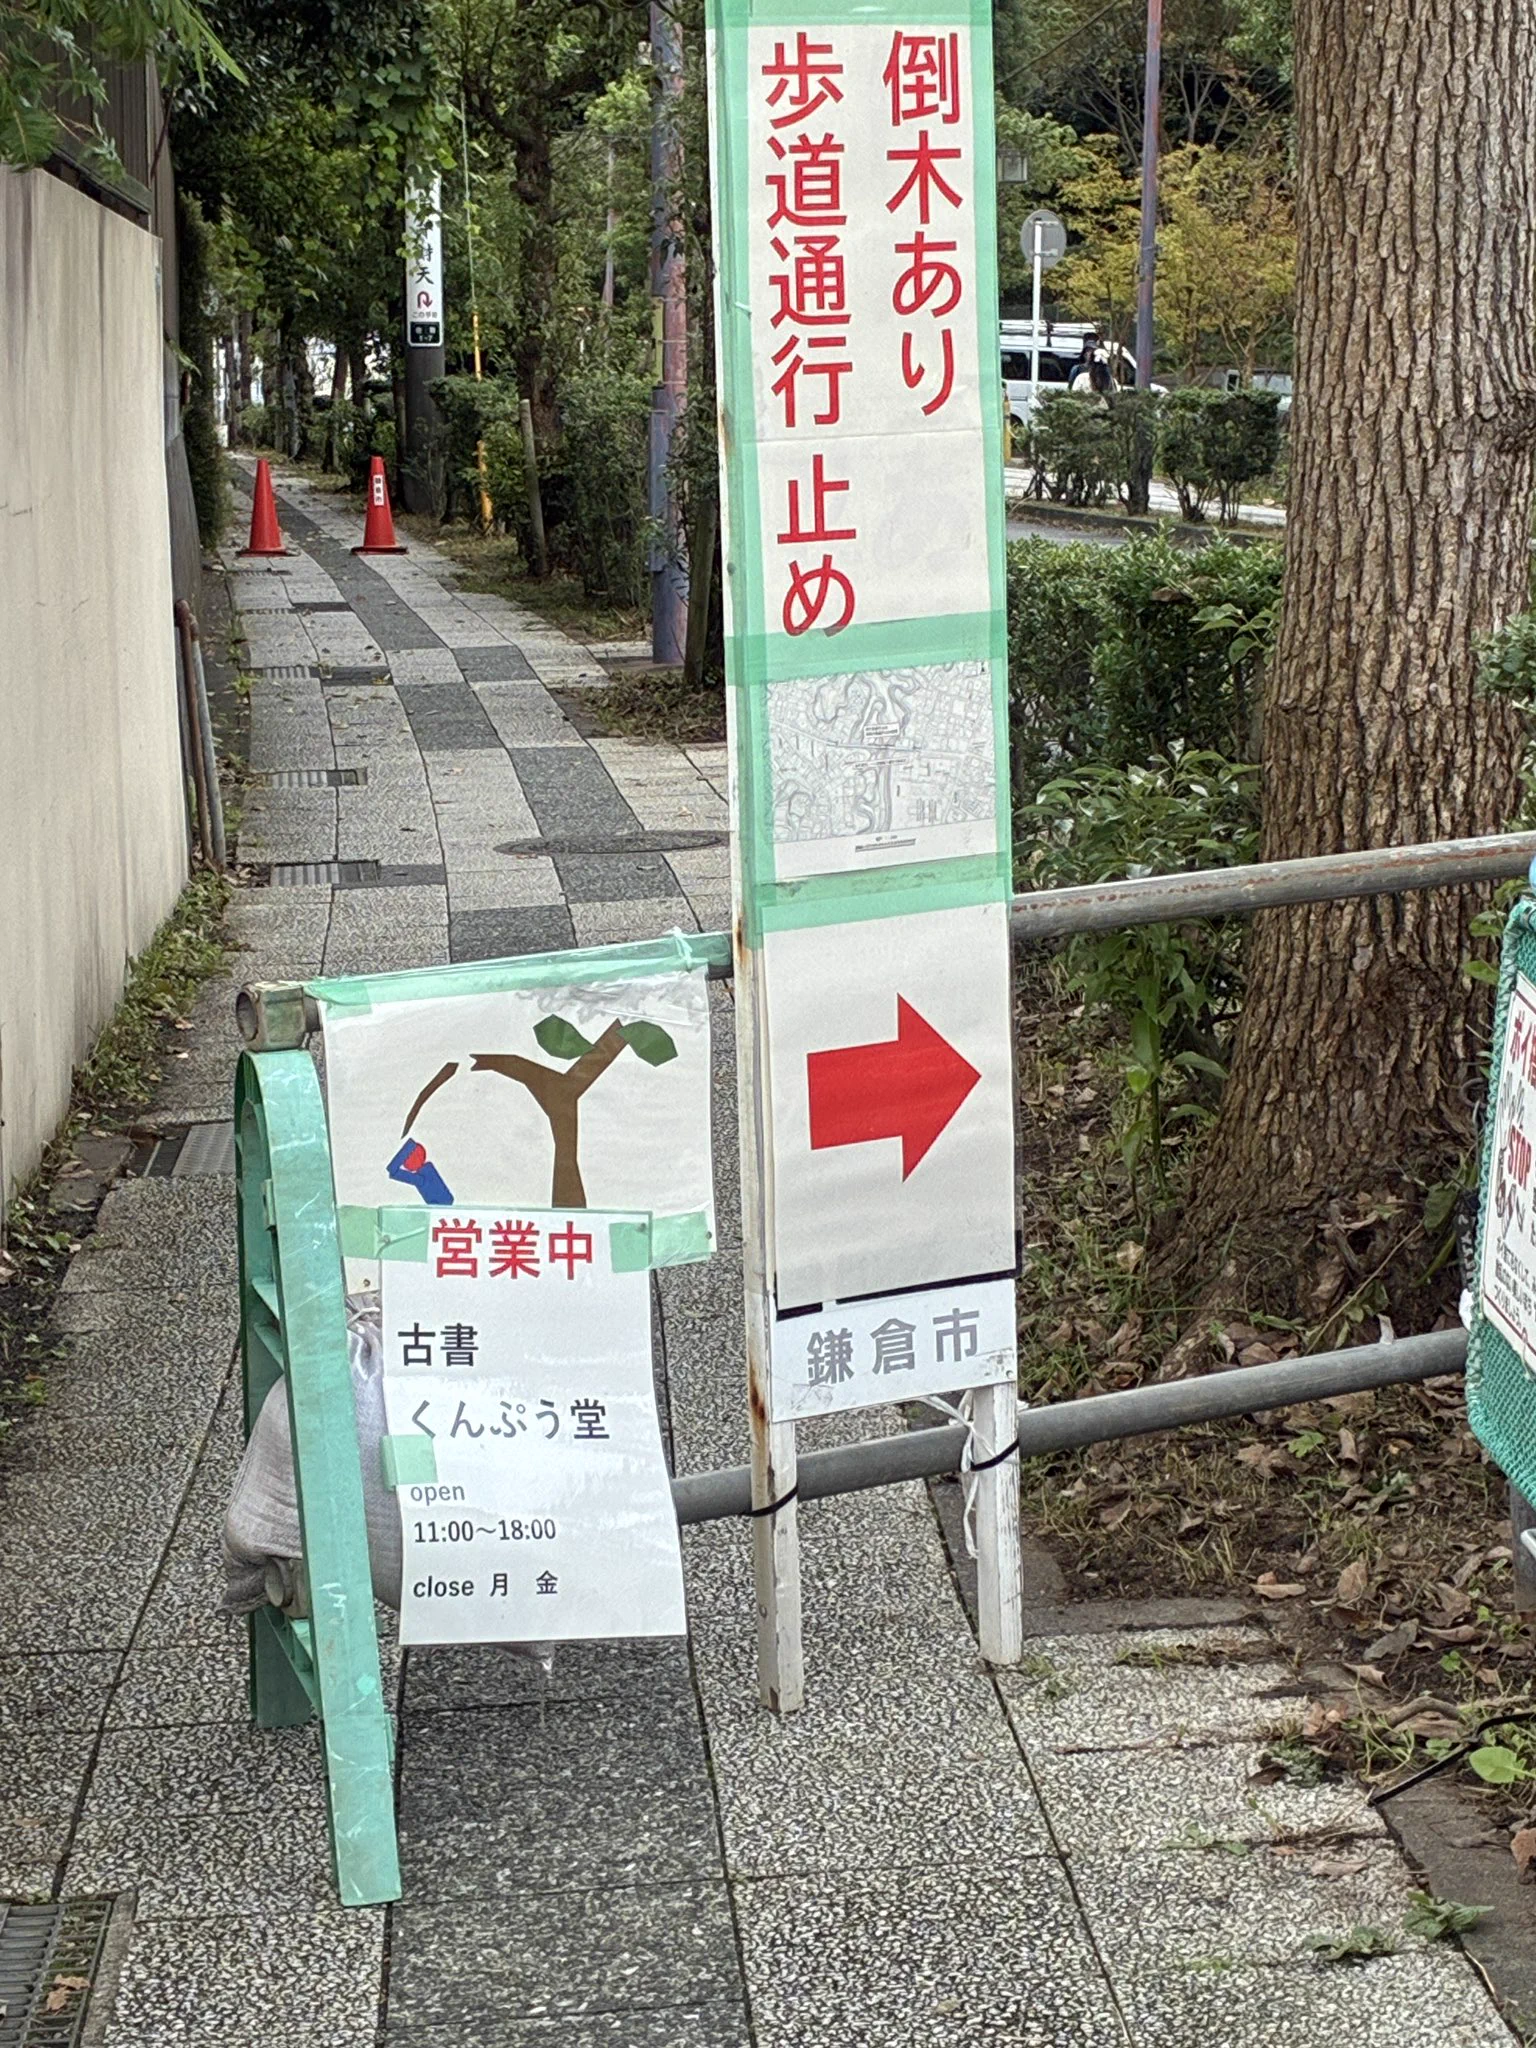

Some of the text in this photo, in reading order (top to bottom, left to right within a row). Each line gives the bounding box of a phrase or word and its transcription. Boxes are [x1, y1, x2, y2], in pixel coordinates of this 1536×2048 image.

[882, 30, 963, 416] 倒木あり
[761, 31, 857, 637] 歩道通行止め
[1508, 1124, 1532, 1191] STOP
[431, 1218, 594, 1280] 営業中
[398, 1322, 479, 1367] 古書
[807, 1307, 980, 1388] 鎌倉市
[411, 1398, 610, 1440] くんぷう堂
[410, 1483, 465, 1506] open
[413, 1570, 559, 1598] close 月 金
